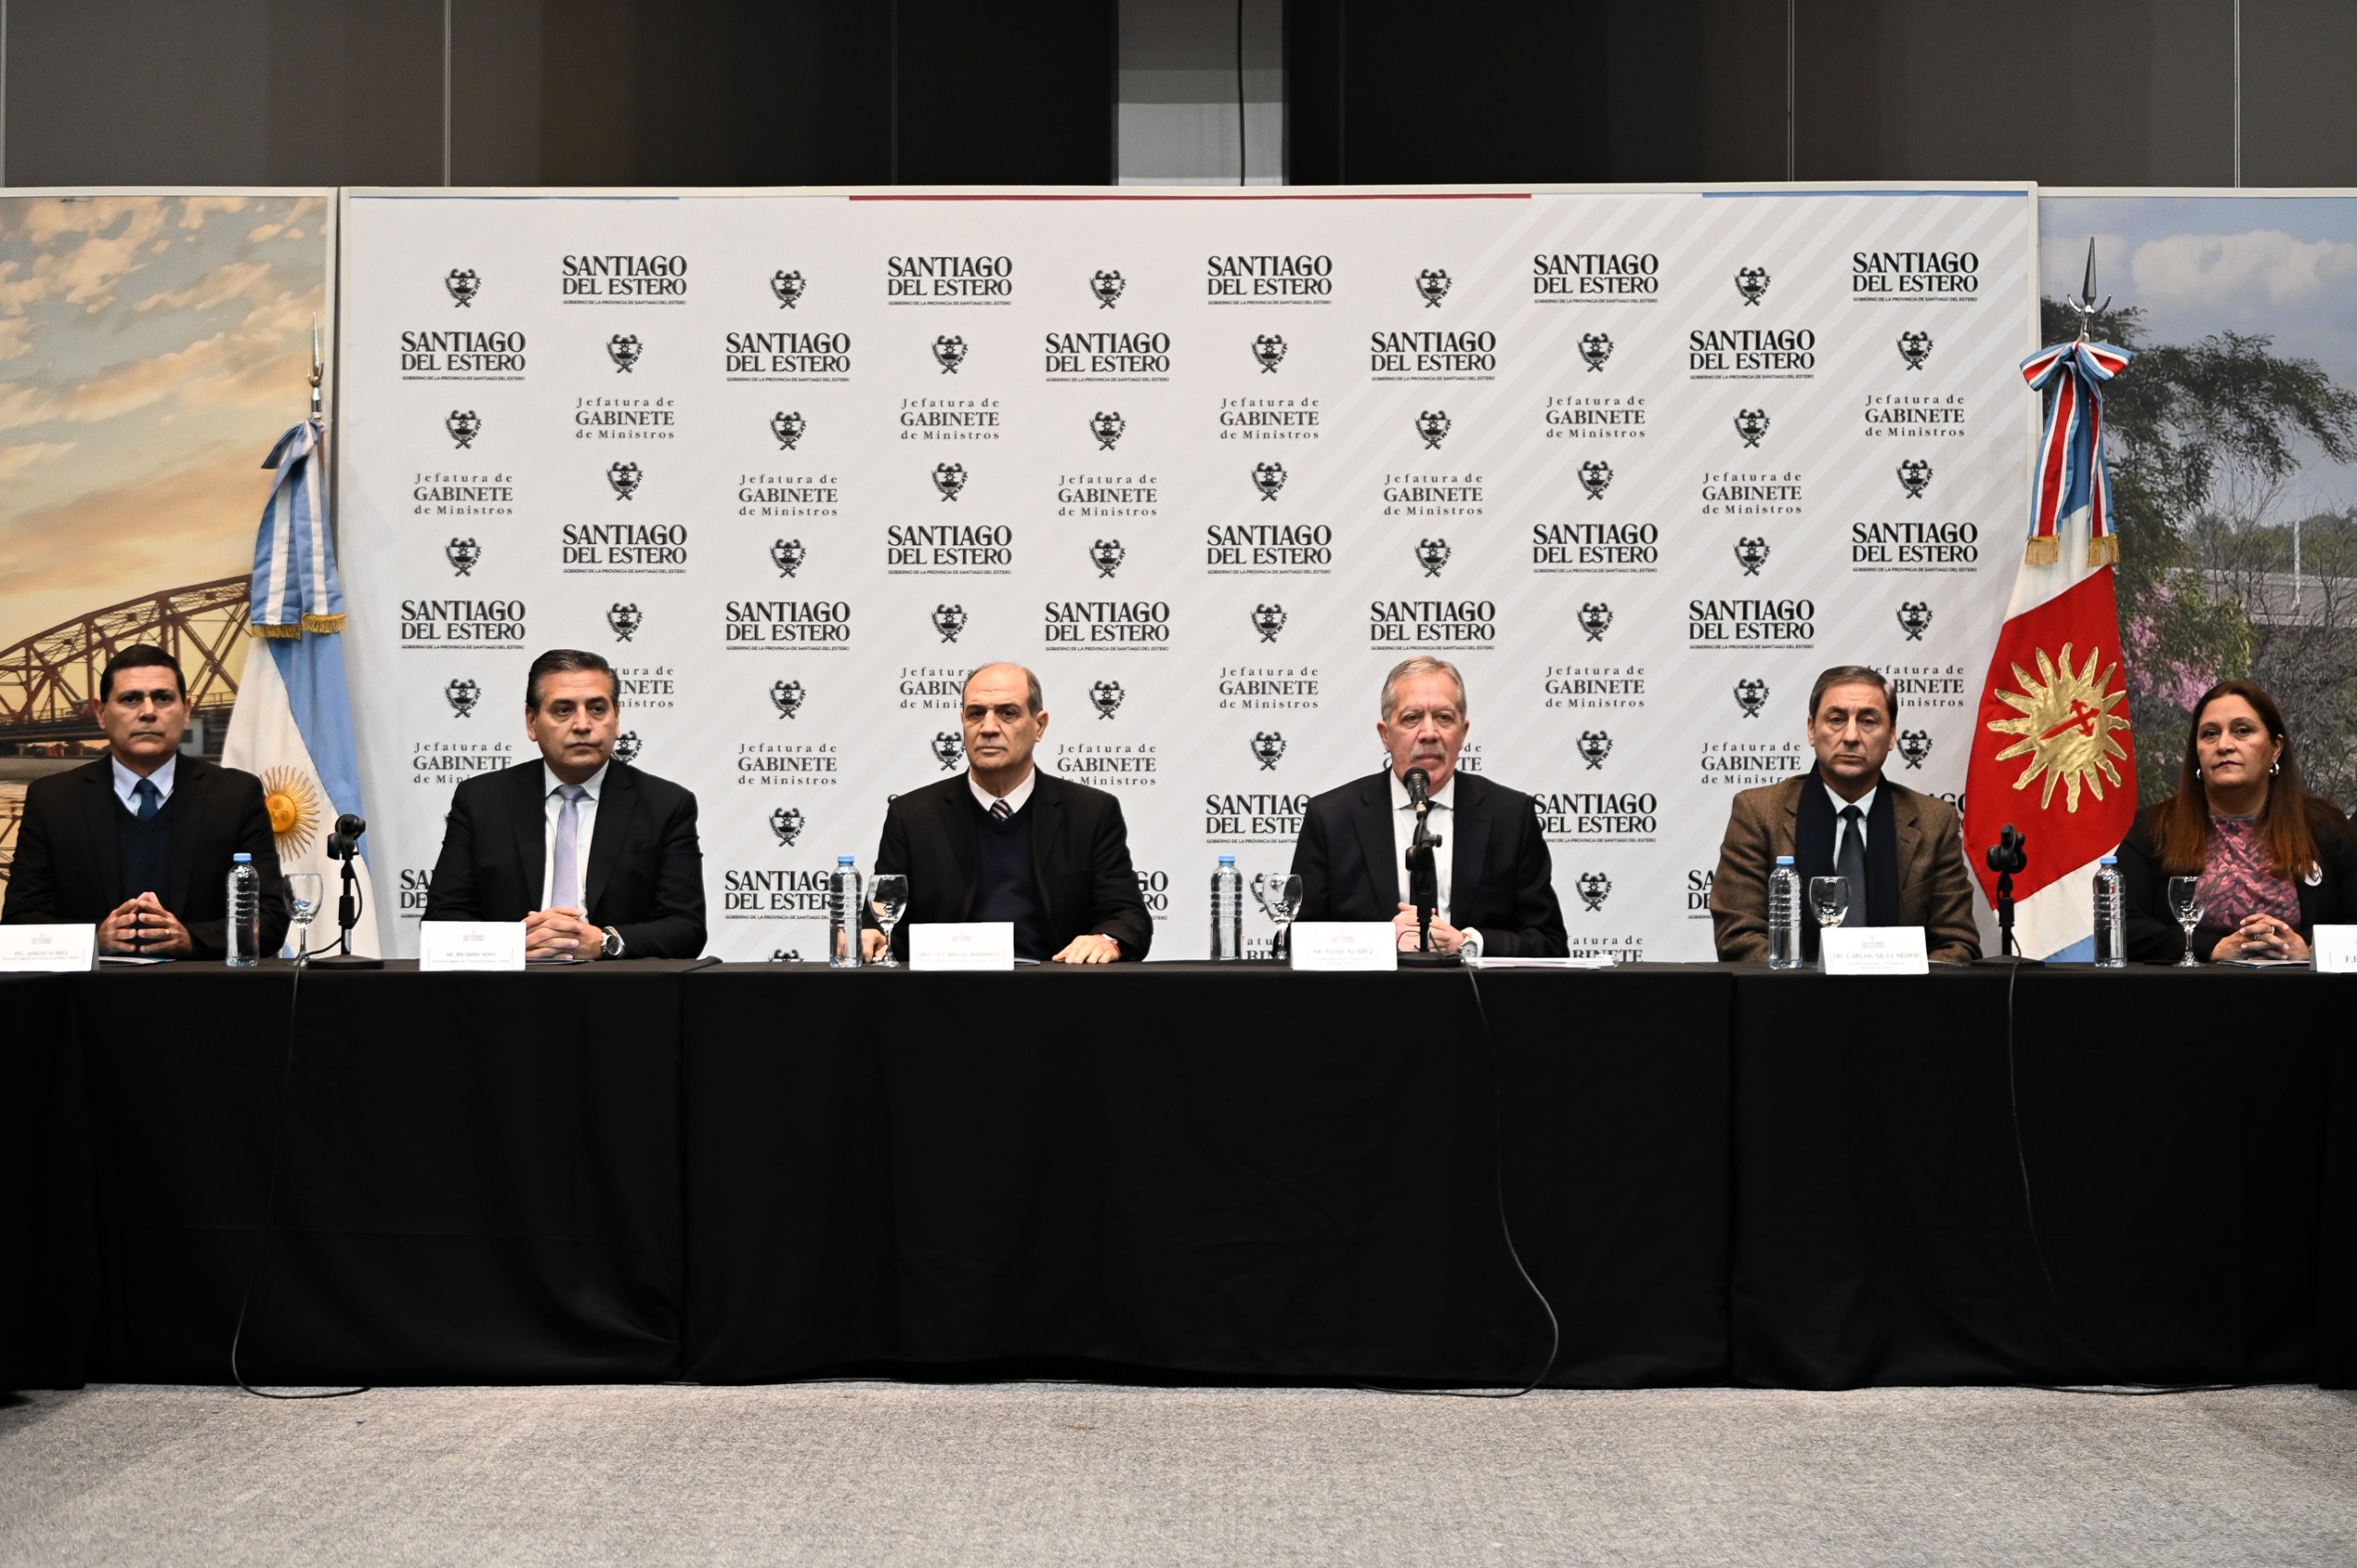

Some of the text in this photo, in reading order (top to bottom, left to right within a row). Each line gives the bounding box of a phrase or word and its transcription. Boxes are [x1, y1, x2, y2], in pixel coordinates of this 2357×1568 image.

[563, 255, 687, 276] SANTIAGO
[888, 256, 1012, 277] SANTIAGO
[1208, 255, 1332, 276] SANTIAGO
[1534, 253, 1658, 274] SANTIAGO
[1853, 251, 1978, 273] SANTIAGO
[563, 278, 687, 295] DEL ESTERO
[888, 279, 1012, 296] DEL ESTERO
[1208, 278, 1332, 295] DEL ESTERO
[1534, 276, 1658, 293] DEL ESTERO
[1853, 274, 1978, 291] DEL ESTERO
[401, 331, 526, 352] SANTIAGO
[726, 332, 851, 354] SANTIAGO
[1046, 332, 1170, 354] SANTIAGO
[1371, 331, 1495, 353] SANTIAGO
[1690, 330, 1815, 351] SANTIAGO
[401, 354, 526, 370] DEL ESTERO
[726, 355, 851, 372] DEL ESTERO
[1046, 355, 1170, 372] DEL ESTERO
[1371, 354, 1495, 371] DEL ESTERO
[1690, 353, 1815, 369] DEL ESTERO
[576, 397, 674, 408] Jefatura de
[1221, 397, 1318, 408] Jefatura de
[1866, 394, 1964, 405] Jefatura de
[575, 411, 675, 425] GABINETE
[900, 412, 1000, 426] GABINETE
[1220, 411, 1319, 425] GABINETE
[1546, 410, 1645, 424] GABINETE
[1865, 408, 1965, 423] GABINETE
[575, 429, 674, 438] de Ministros
[1220, 429, 1318, 438] de Ministros
[1865, 426, 1964, 436] de Ministros
[415, 472, 513, 483] Jefatura de
[1059, 474, 1156, 485] Jefatura de
[1703, 471, 1801, 482] Jefatura de
[414, 486, 514, 501] GABINETE
[738, 488, 838, 503] GABINETE
[1058, 488, 1157, 503] GABINETE
[1384, 487, 1483, 502] GABINETE
[1702, 485, 1802, 500] GABINETE
[414, 505, 513, 514] de Ministros
[1058, 506, 1156, 516] de Ministros
[1702, 504, 1801, 513] de Ministros
[563, 524, 687, 545] SANTIAGO
[888, 525, 1012, 546] SANTIAGO
[1207, 525, 1331, 546] SANTIAGO
[1533, 523, 1657, 544] SANTIAGO
[1852, 522, 1977, 543] SANTIAGO
[563, 547, 687, 563] DEL ESTERO
[888, 548, 1012, 564] DEL ESTERO
[1207, 548, 1331, 564] DEL ESTERO
[1533, 546, 1657, 563] DEL ESTERO
[1852, 545, 1977, 562] DEL ESTERO
[401, 599, 526, 621] SANTIAGO
[726, 601, 850, 622] SANTIAGO
[1045, 601, 1169, 622] SANTIAGO
[1371, 600, 1495, 621] SANTIAGO
[1689, 599, 1814, 621] SANTIAGO
[401, 622, 526, 639] DEL ESTERO
[726, 624, 850, 641] DEL ESTERO
[1045, 624, 1169, 641] DEL ESTERO
[1371, 623, 1495, 640] DEL ESTERO
[1689, 622, 1814, 639] DEL ESTERO
[1546, 666, 1643, 677] Jefatura de
[619, 679, 674, 694] INETE
[900, 680, 962, 695] GABIN
[1219, 680, 1318, 695] GABINETE
[1545, 679, 1644, 694] GABINETE
[1893, 679, 1964, 693] BINETE
[1545, 698, 1643, 707] de Ministros
[738, 743, 836, 754] Jefatura de
[413, 755, 513, 770] GABINETE
[737, 757, 837, 772] GABINETE
[1057, 757, 1156, 772] GABINETE
[1701, 756, 1801, 771] GABINETE
[737, 775, 836, 784] de Ministros
[1206, 794, 1308, 815] SANTIAG
[1534, 793, 1657, 814] SANTIAGO
[1206, 817, 1302, 833] DEL ESTE
[1578, 816, 1656, 832] ESTERO
[725, 870, 830, 891] SANTIAG
[725, 893, 830, 910] DEL ESTER
